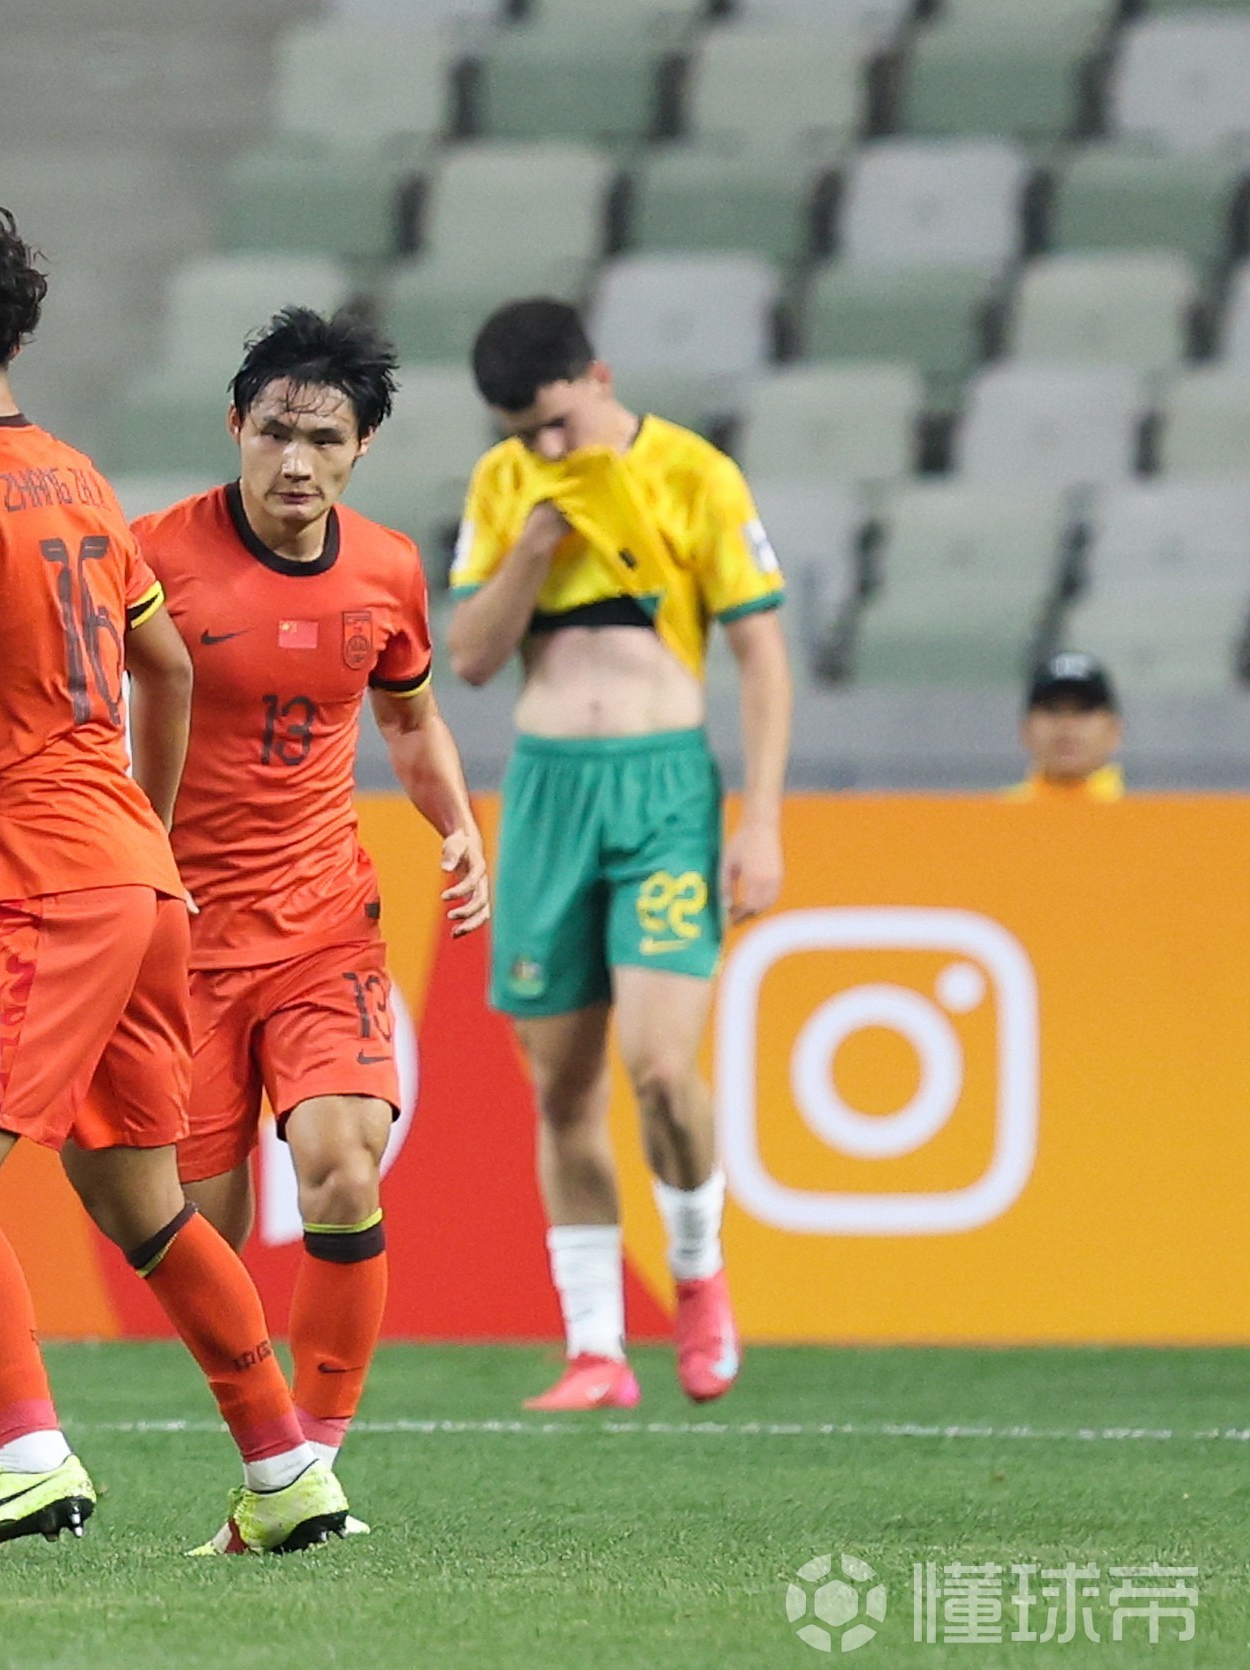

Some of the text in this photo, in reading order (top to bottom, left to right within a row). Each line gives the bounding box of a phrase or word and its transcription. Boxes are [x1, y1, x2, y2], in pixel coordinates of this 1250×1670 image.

[39, 534, 124, 725] 16
[260, 694, 317, 766] 13
[342, 972, 392, 1043] 13
